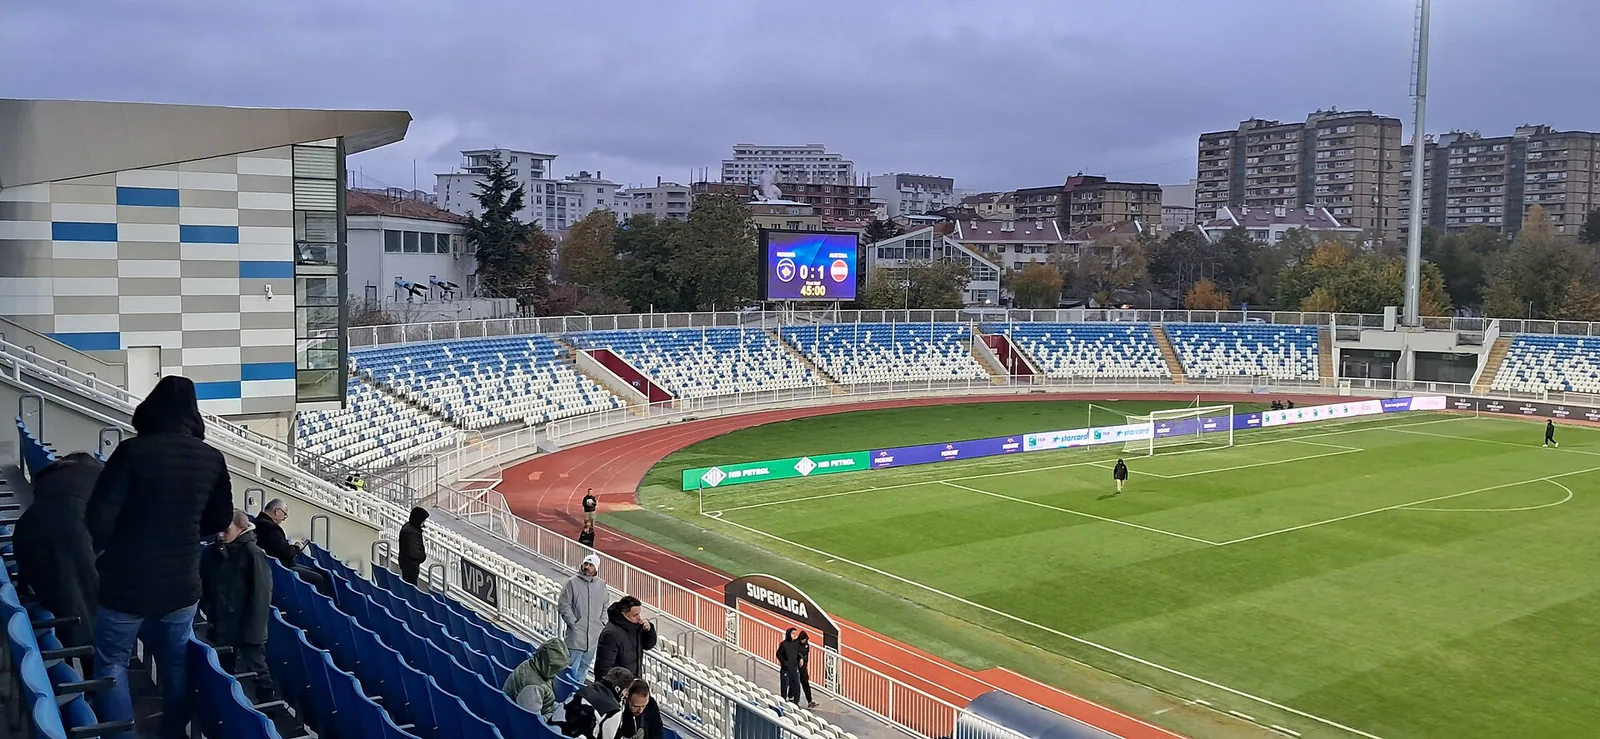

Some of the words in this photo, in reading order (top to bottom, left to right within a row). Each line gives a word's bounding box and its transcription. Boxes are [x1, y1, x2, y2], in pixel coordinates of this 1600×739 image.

[800, 285, 826, 296] 45:00
[1061, 432, 1090, 442] starcard
[463, 562, 484, 595] VIP
[486, 575, 495, 603] 2
[746, 582, 808, 618] SUPERLIGA
